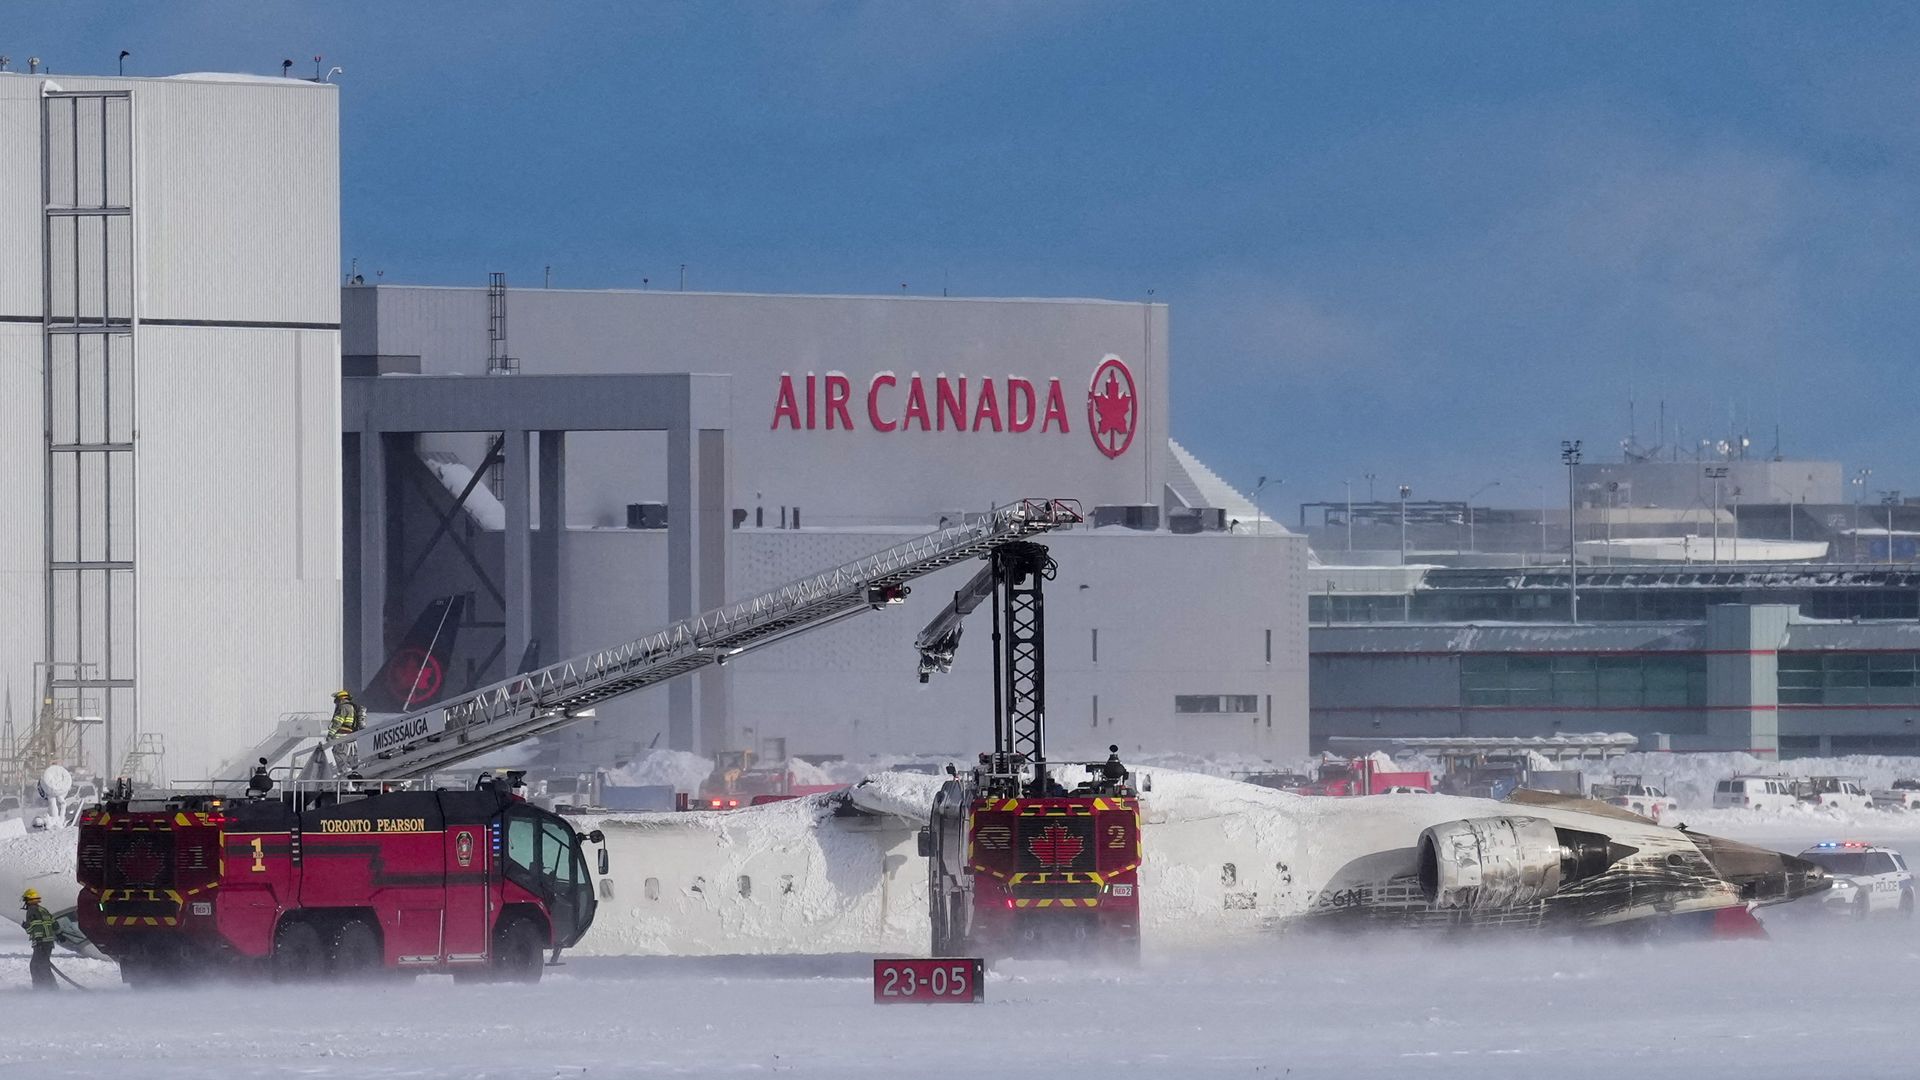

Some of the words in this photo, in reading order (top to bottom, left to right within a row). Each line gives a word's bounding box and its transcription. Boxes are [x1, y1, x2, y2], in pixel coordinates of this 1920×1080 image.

[771, 373, 854, 430] AIR
[867, 372, 1071, 433] CANADA
[373, 717, 429, 751] MISSISSAUGA
[320, 819, 371, 833] TORONTO
[376, 818, 425, 832] PEARSON
[1108, 826, 1125, 848] 2
[251, 838, 265, 872] 1
[1875, 881, 1897, 892] POLICE
[883, 967, 966, 996] 23-05
